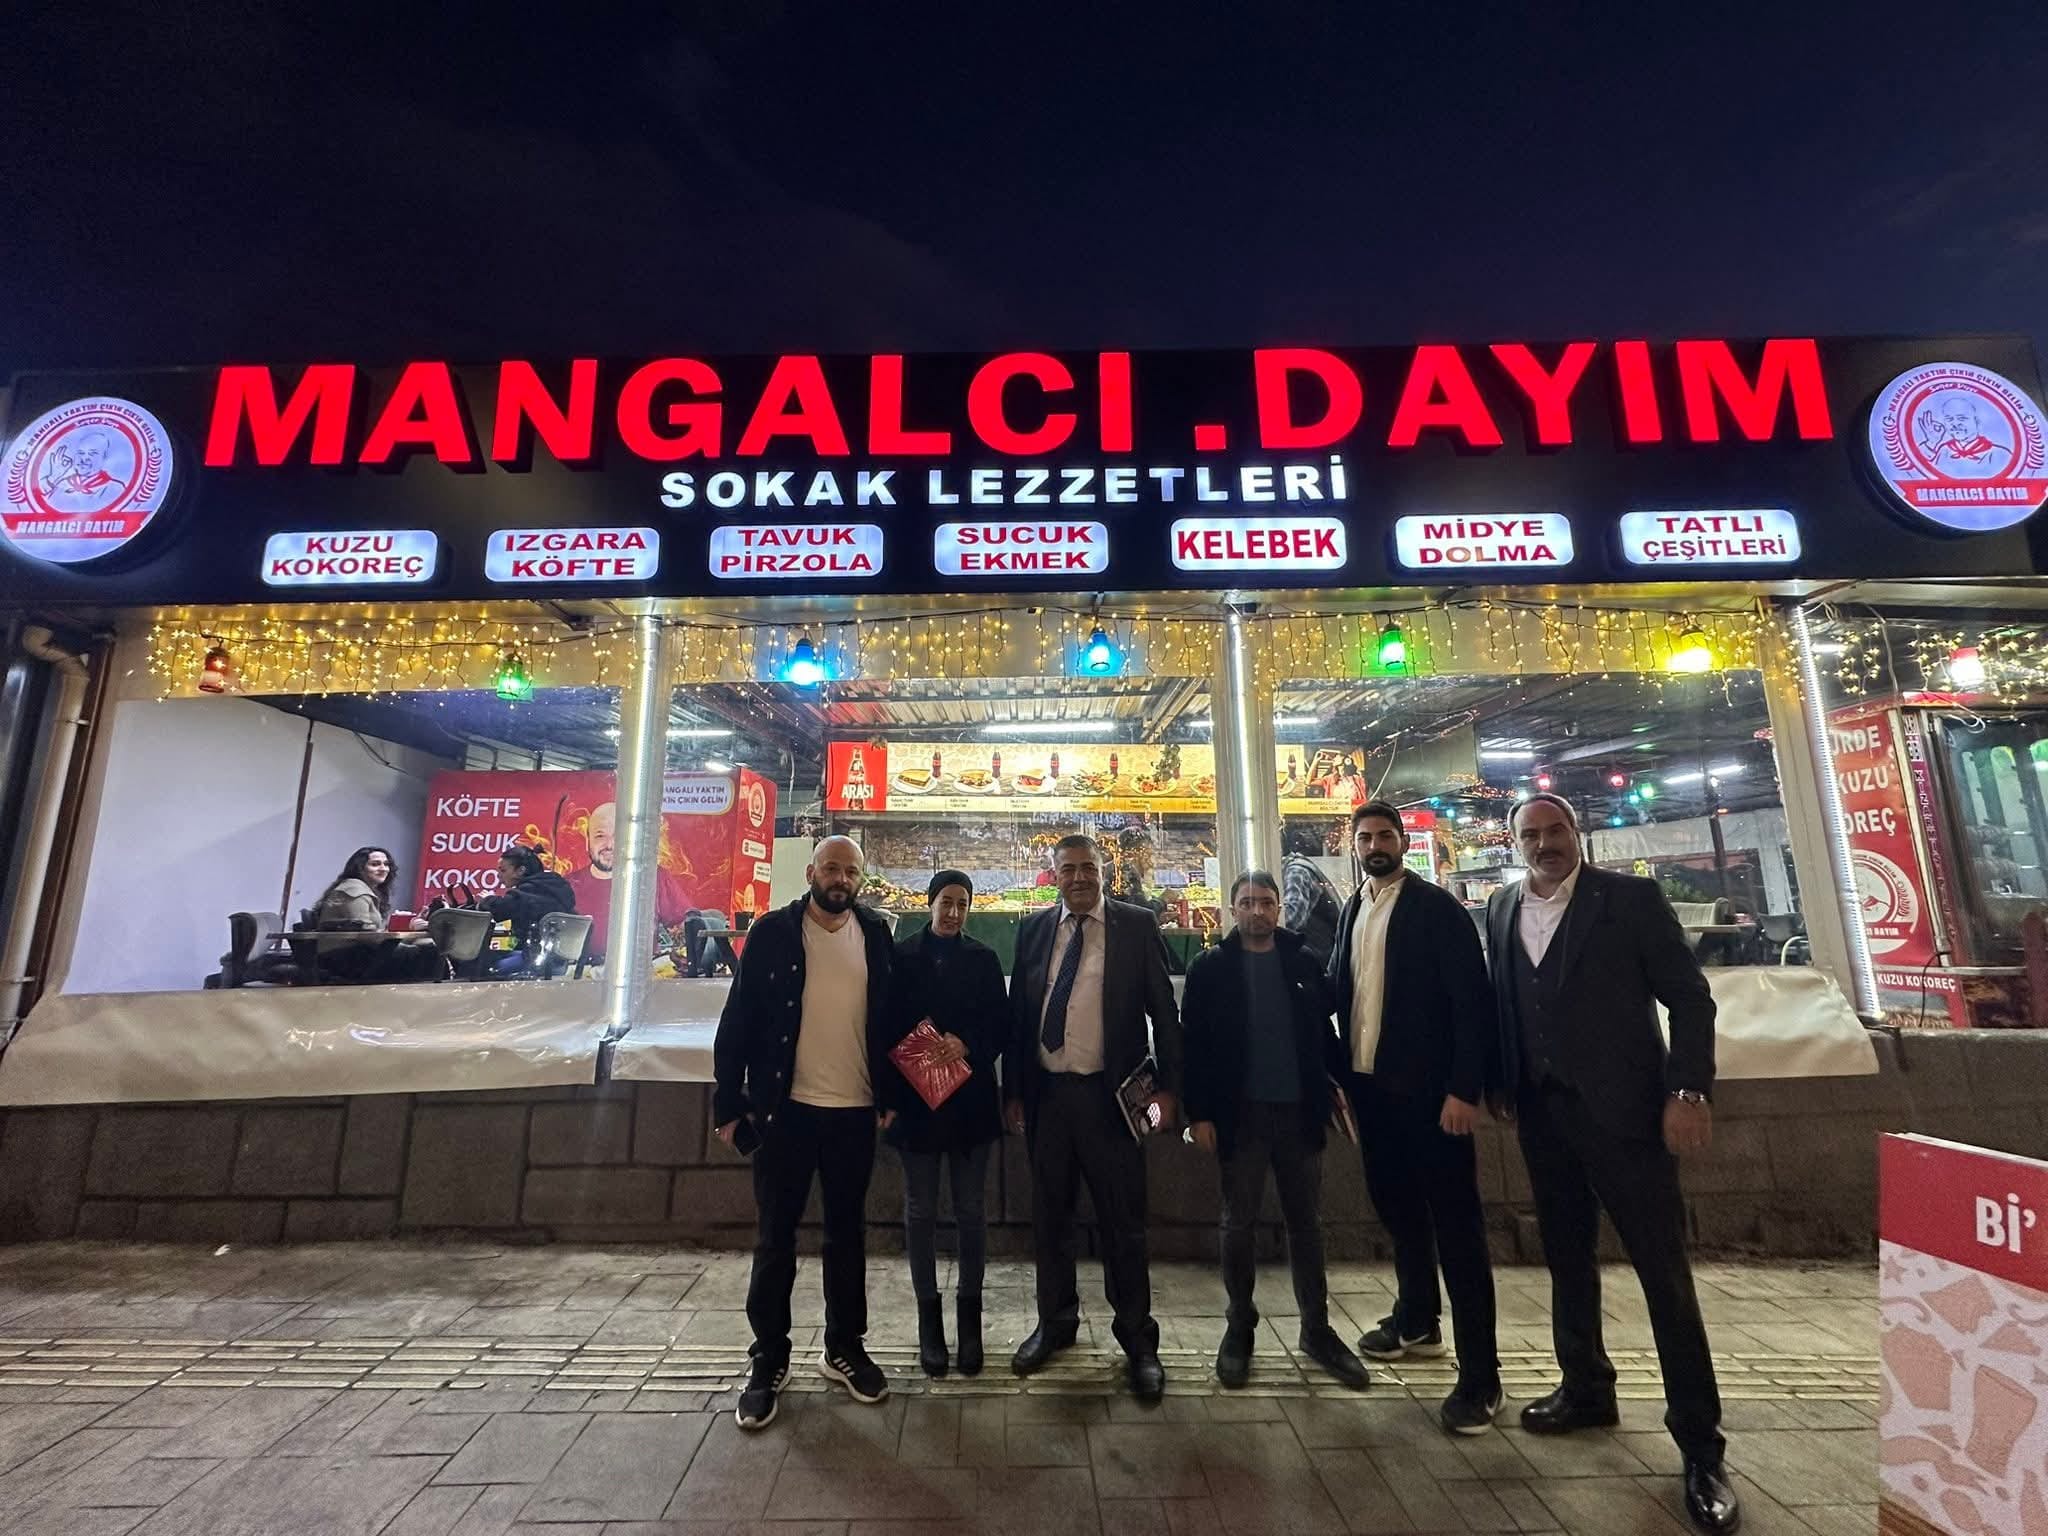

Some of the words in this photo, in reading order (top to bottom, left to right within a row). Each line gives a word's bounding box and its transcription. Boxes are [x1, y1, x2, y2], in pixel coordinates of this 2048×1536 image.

[204, 351, 1132, 466] MANGALCI
[660, 470, 897, 508] SOKAK
[928, 455, 1348, 505] LEZZETLERİ
[957, 526, 1094, 545] SUCUK
[1424, 518, 1546, 540] MİDYE
[1656, 515, 1764, 534] TATLI
[306, 536, 394, 554] KUZU
[504, 533, 647, 552] IZGARA
[738, 527, 856, 546] TAVUK
[1177, 528, 1341, 561] KELEBEK
[1419, 544, 1558, 565] DOLMA
[1642, 534, 1787, 563] ÇEŞİTLERİ
[271, 556, 425, 578] KOKOREÇ
[511, 556, 636, 578] KÖFTE
[719, 550, 873, 573] PİRZOLA
[960, 552, 1091, 571] EKMEK
[841, 783, 874, 799] ARASI
[436, 794, 521, 818] KÖFTE
[431, 832, 521, 854] SUCUK
[1877, 973, 1904, 986] KUZU
